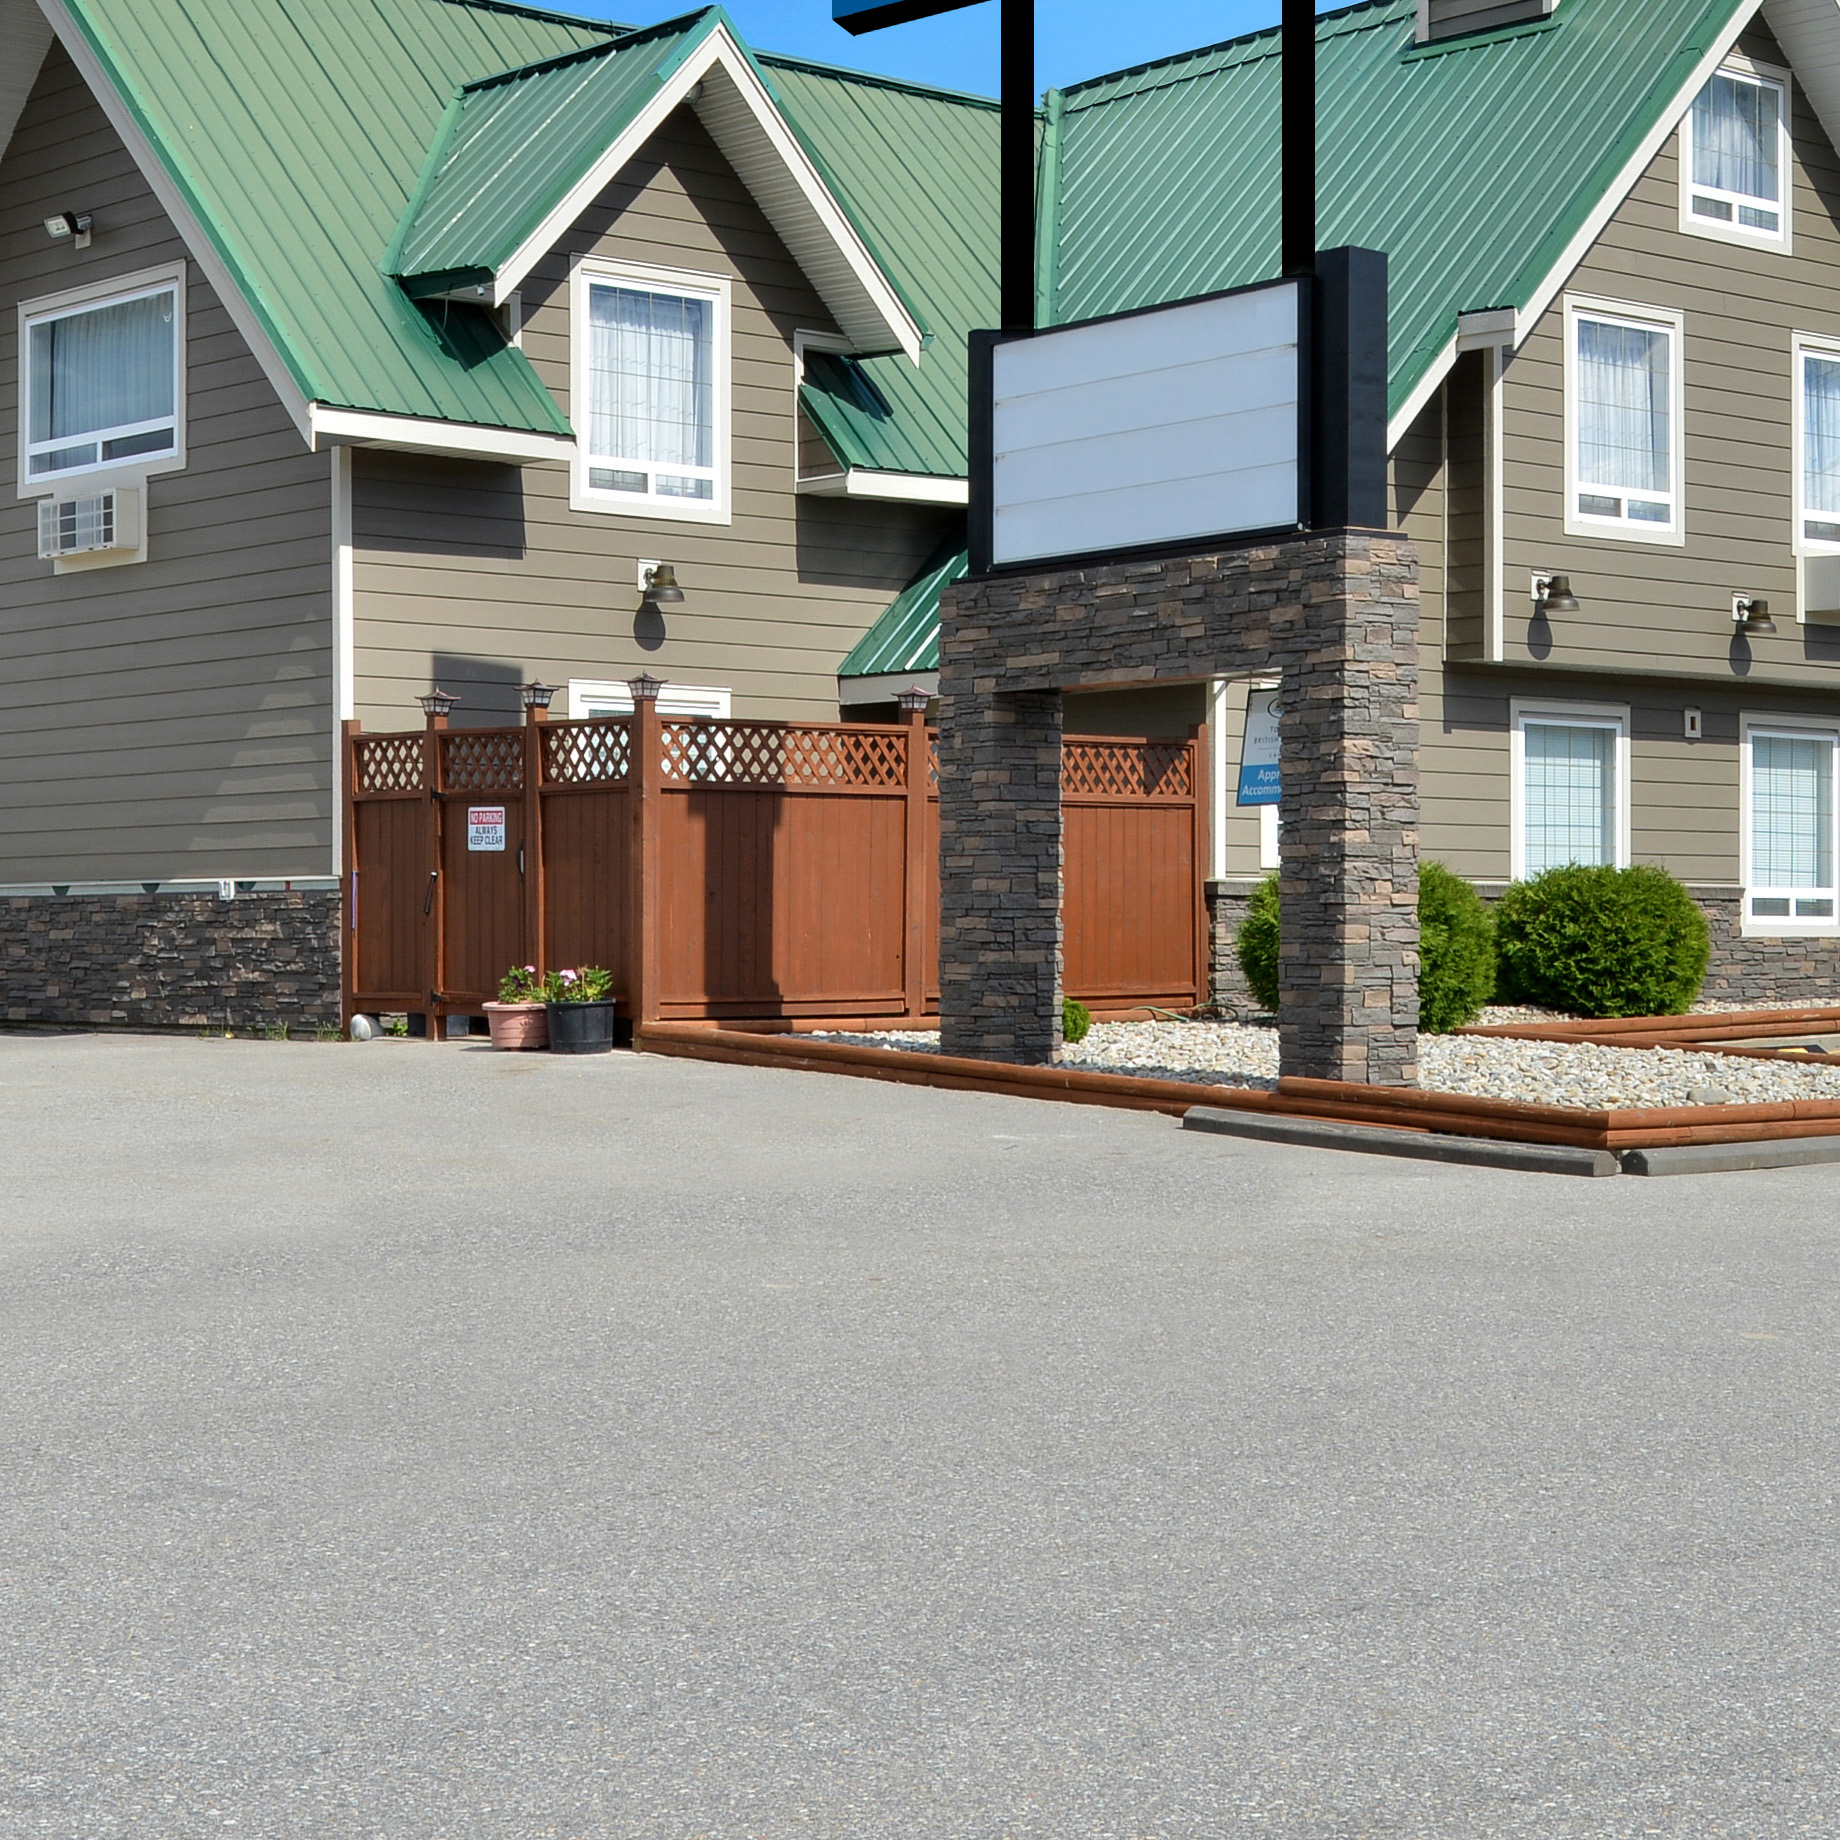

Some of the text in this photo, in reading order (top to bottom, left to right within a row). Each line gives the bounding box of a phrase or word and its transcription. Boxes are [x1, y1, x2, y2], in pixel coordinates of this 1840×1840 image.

[1257, 769, 1281, 783] Appr
[470, 812, 503, 824] NO PARKING
[475, 825, 498, 835] ALWAYS
[470, 835, 502, 845] KEEP CLEAR
